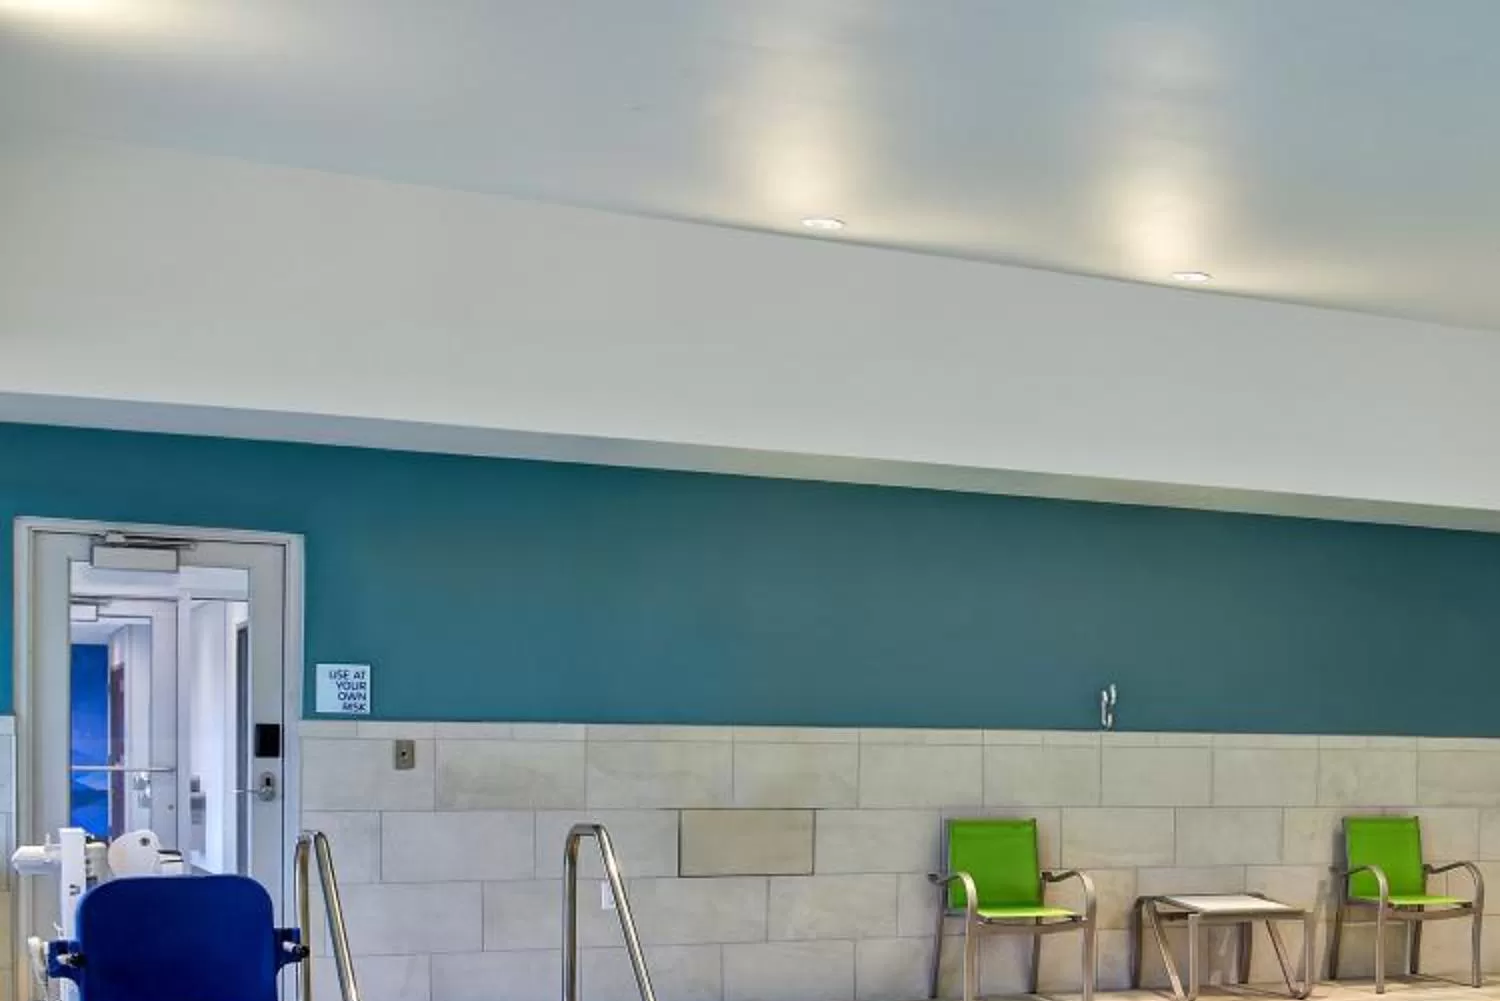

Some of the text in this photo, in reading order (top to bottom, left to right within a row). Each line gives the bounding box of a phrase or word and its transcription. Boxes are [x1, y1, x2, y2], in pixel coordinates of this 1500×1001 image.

[329, 670, 365, 680] USE AT
[336, 681, 367, 690] YOUR
[338, 691, 367, 701] OWN
